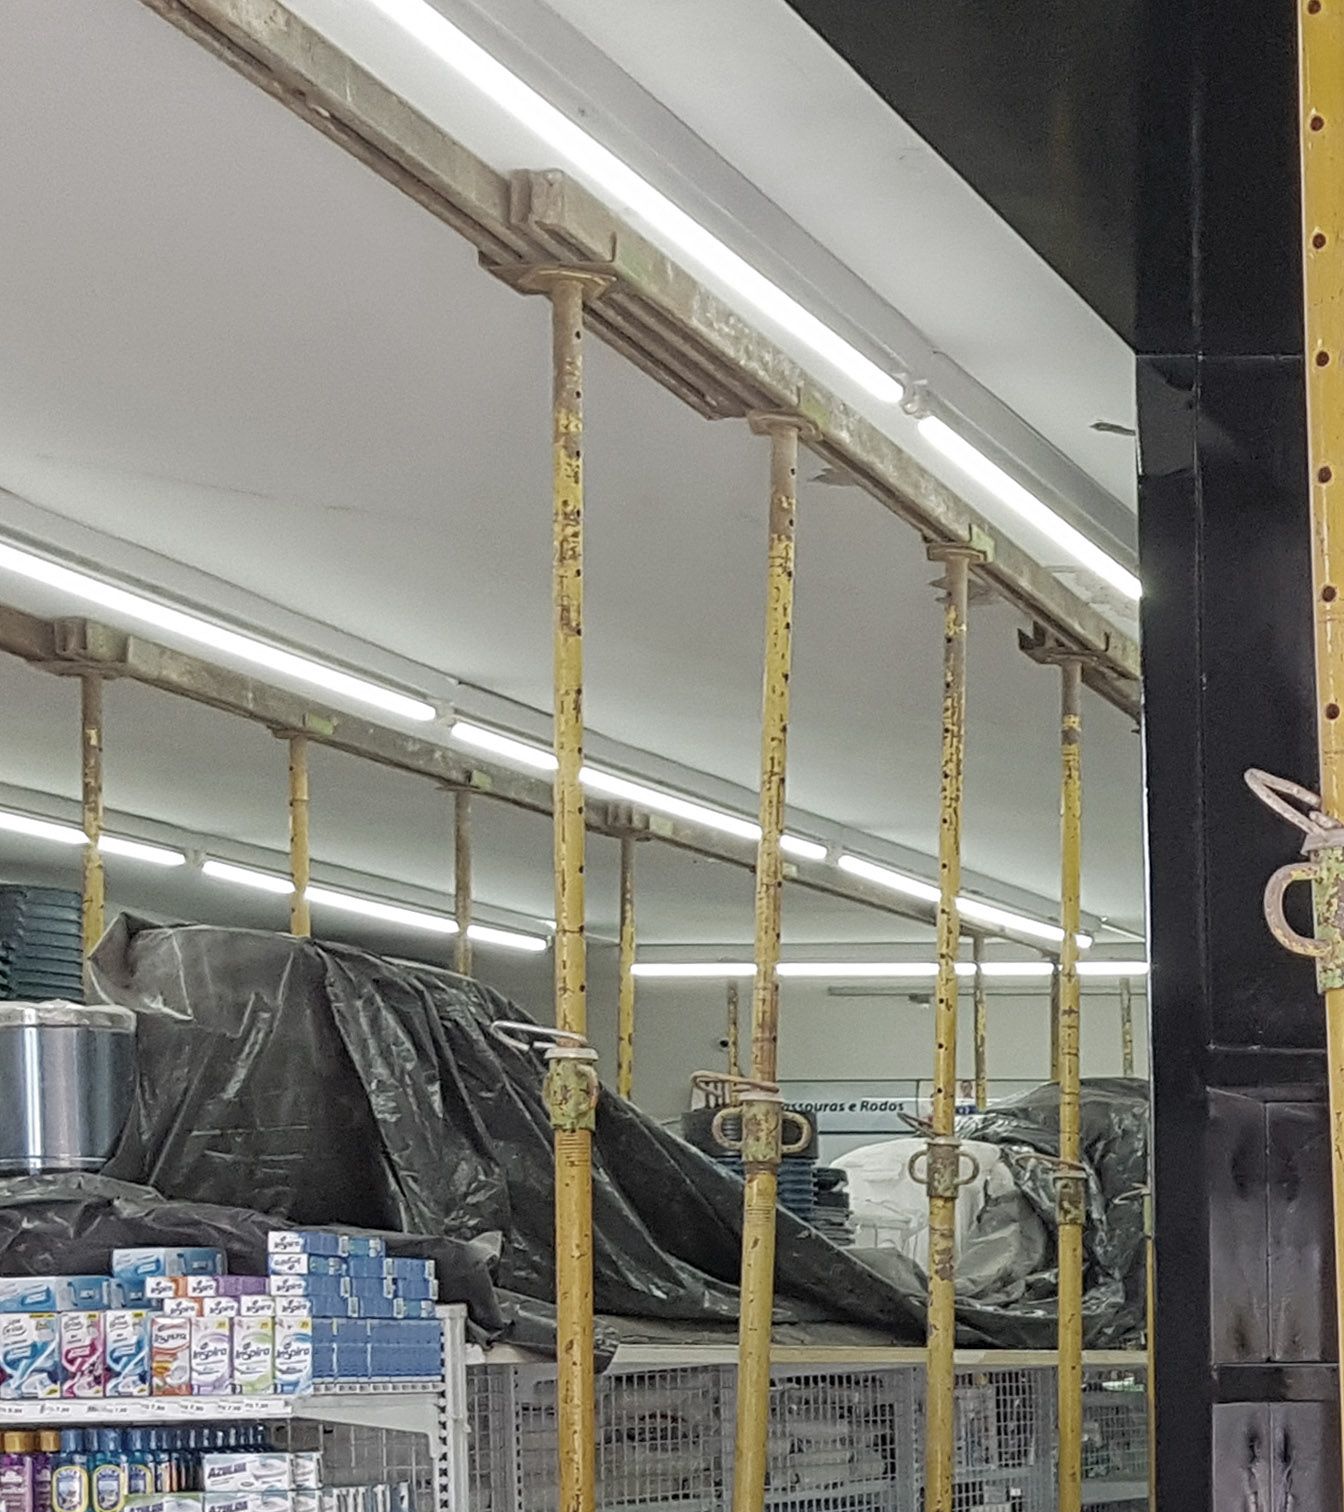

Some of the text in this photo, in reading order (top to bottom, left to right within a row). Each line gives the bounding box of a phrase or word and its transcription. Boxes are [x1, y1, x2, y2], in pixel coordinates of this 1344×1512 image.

[781, 1100, 905, 1113] assouras e Rodos
